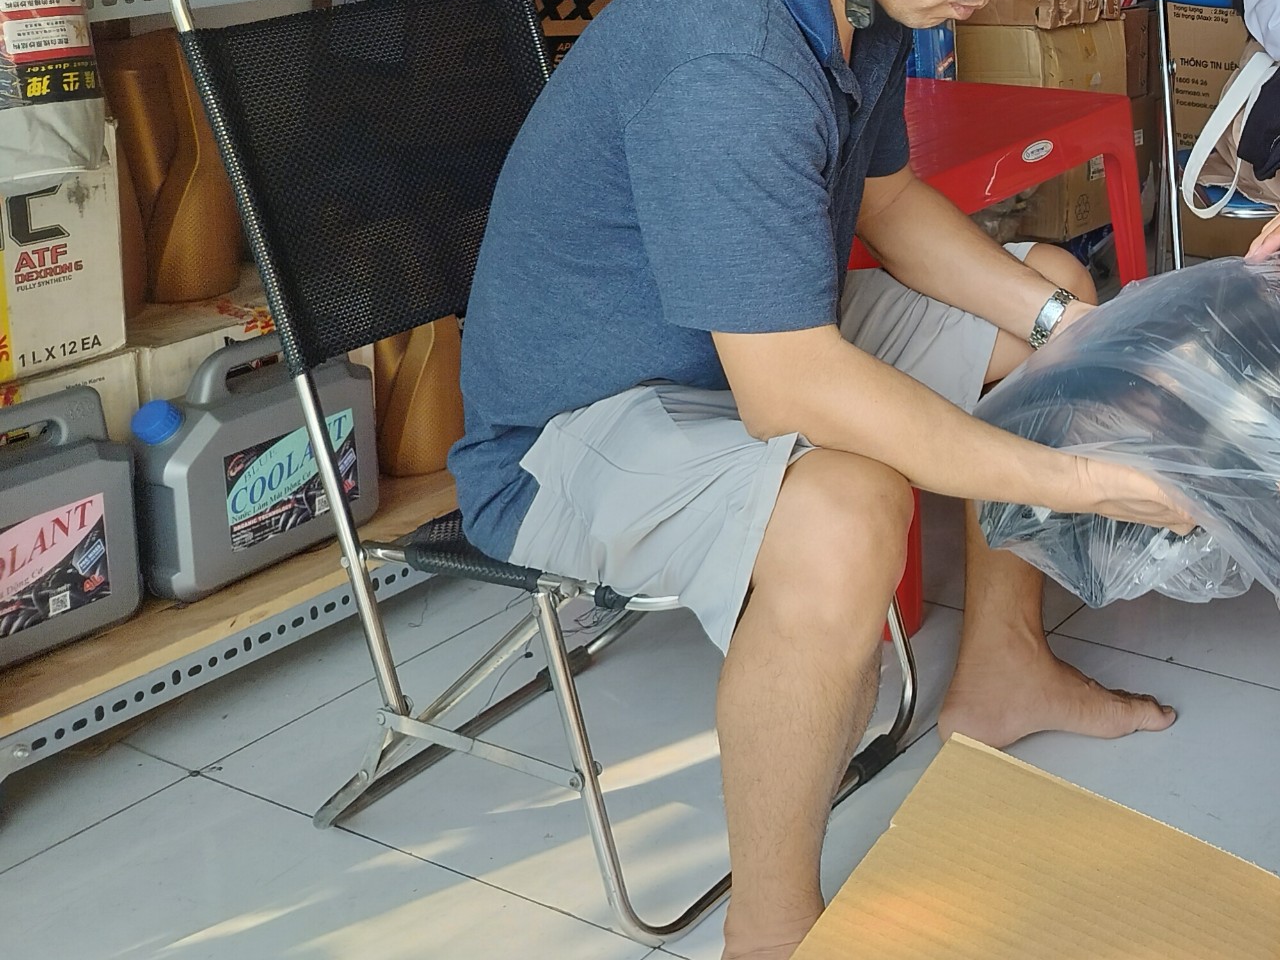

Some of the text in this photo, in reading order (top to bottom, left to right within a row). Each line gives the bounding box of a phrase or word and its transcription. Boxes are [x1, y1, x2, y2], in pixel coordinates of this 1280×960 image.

[1221, 16, 1229, 24] kg
[1180, 57, 1209, 69] THÔNG
[1210, 60, 1222, 70] TIN
[14, 243, 68, 273] ATF
[15, 260, 84, 285] DEXRON 6
[16, 274, 73, 293] FULLY SYNTHETIC
[18, 334, 102, 368] 1 L X 12 EA
[231, 415, 347, 515] COOLAT
[0, 499, 93, 581] LANT
